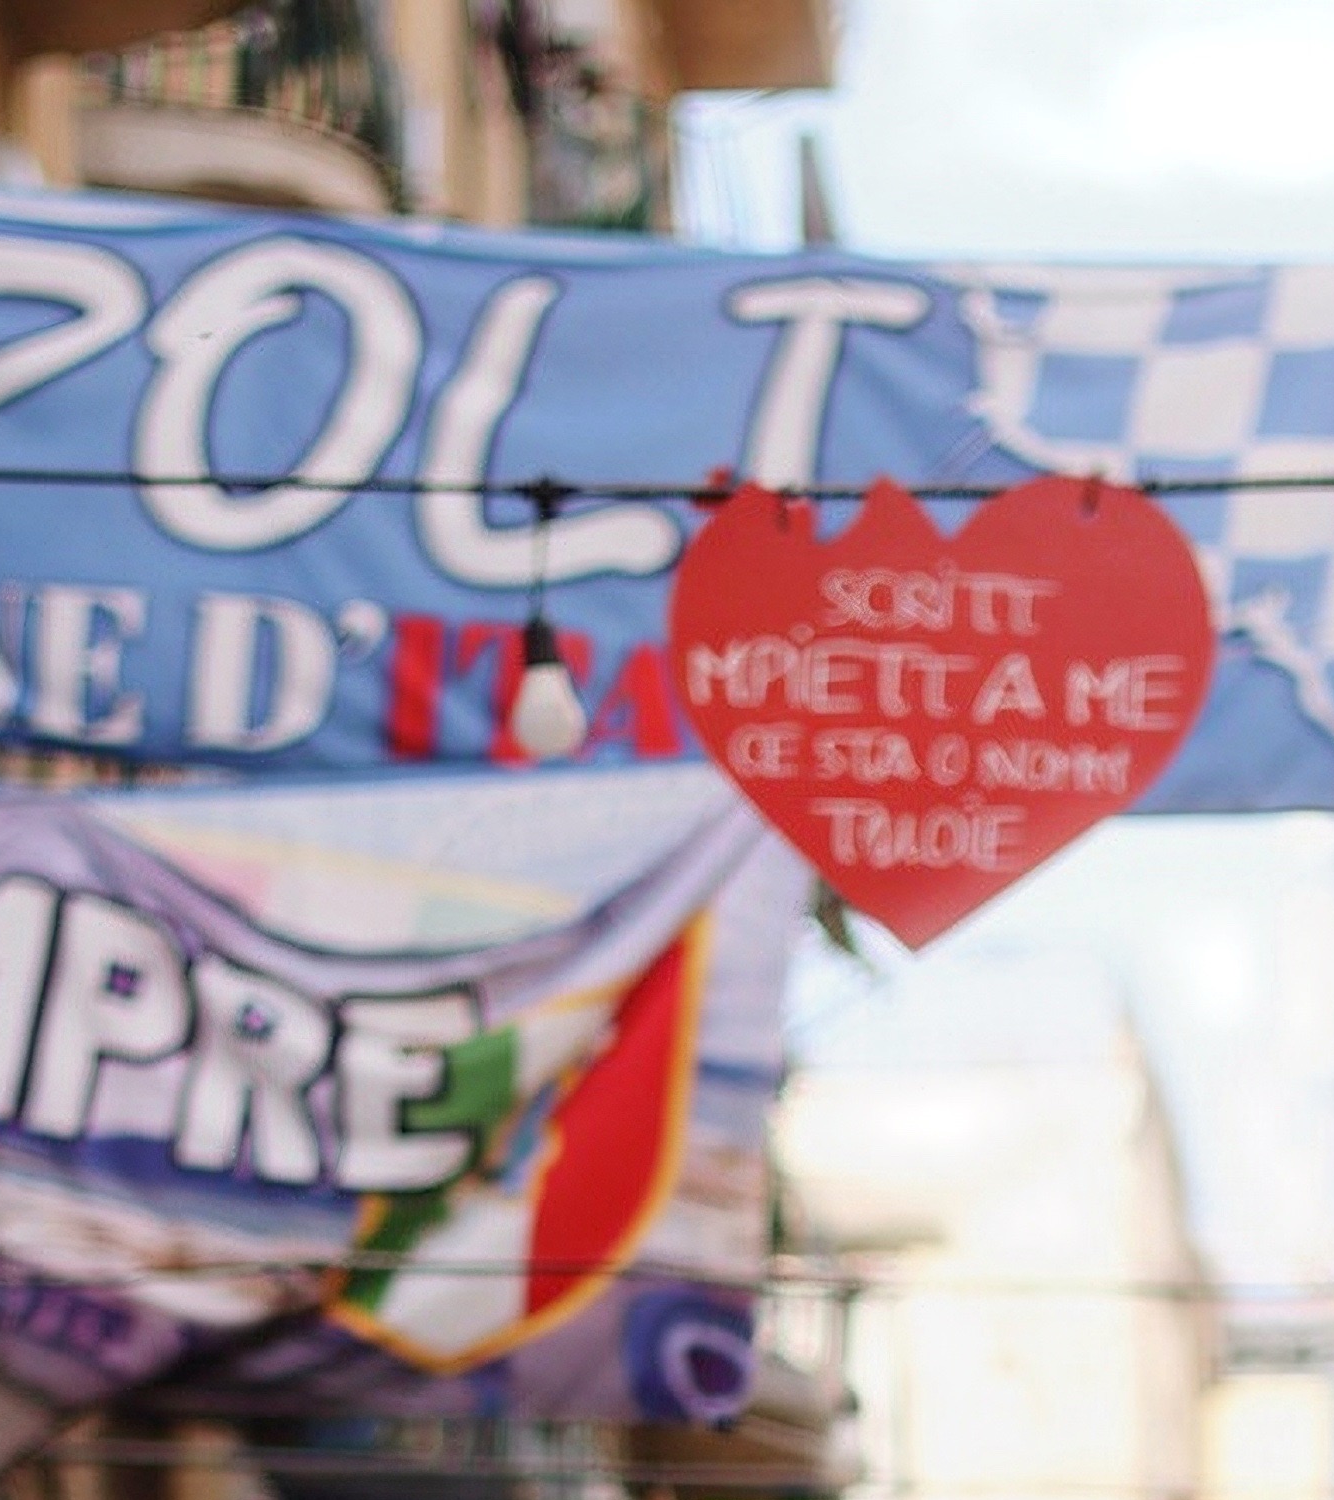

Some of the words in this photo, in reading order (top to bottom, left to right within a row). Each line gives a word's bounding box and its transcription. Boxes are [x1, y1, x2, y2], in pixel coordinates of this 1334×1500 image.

[182, 588, 687, 768] D'ITA
[971, 652, 1045, 726] A
[1066, 652, 1187, 732] ME
